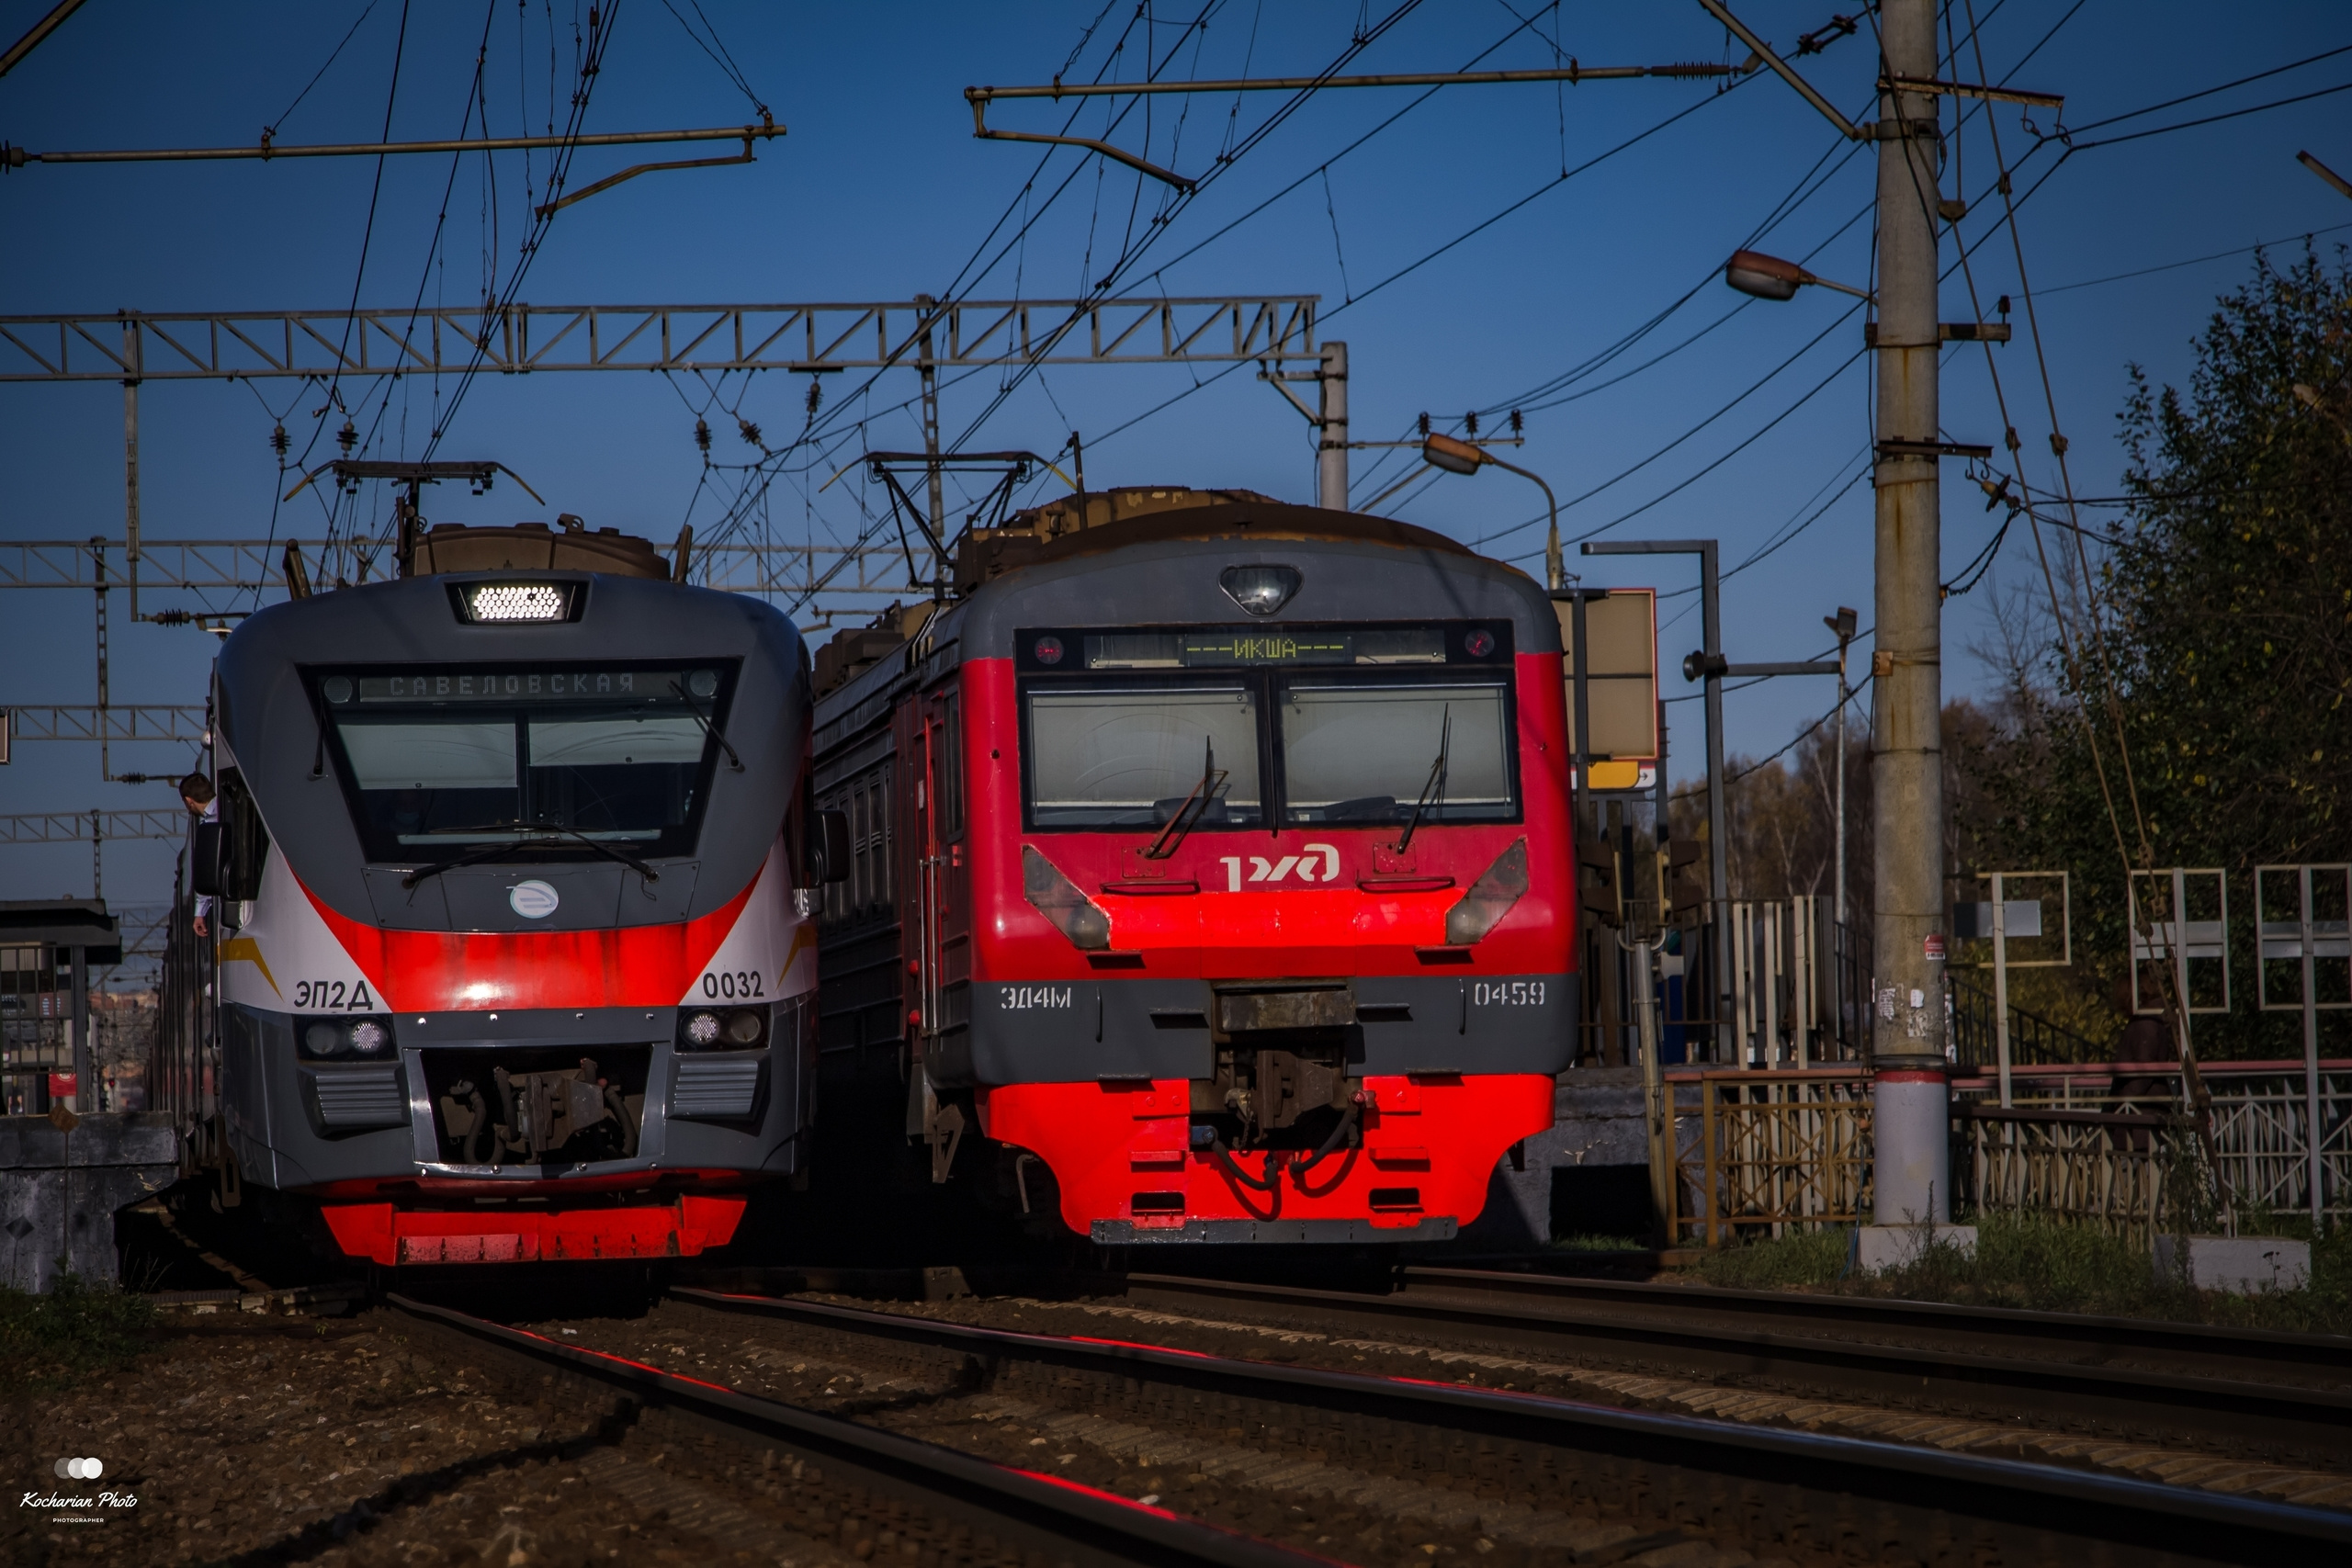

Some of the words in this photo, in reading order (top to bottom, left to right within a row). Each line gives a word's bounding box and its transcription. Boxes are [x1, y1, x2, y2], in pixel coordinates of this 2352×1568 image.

[390, 672, 633, 695] САВЕЛОВСКАЯ
[293, 979, 374, 1012] ЭП2Д
[702, 970, 764, 999] 0032
[1474, 981, 1545, 1006] 0459
[1001, 987, 1071, 1010] ЭД4М
